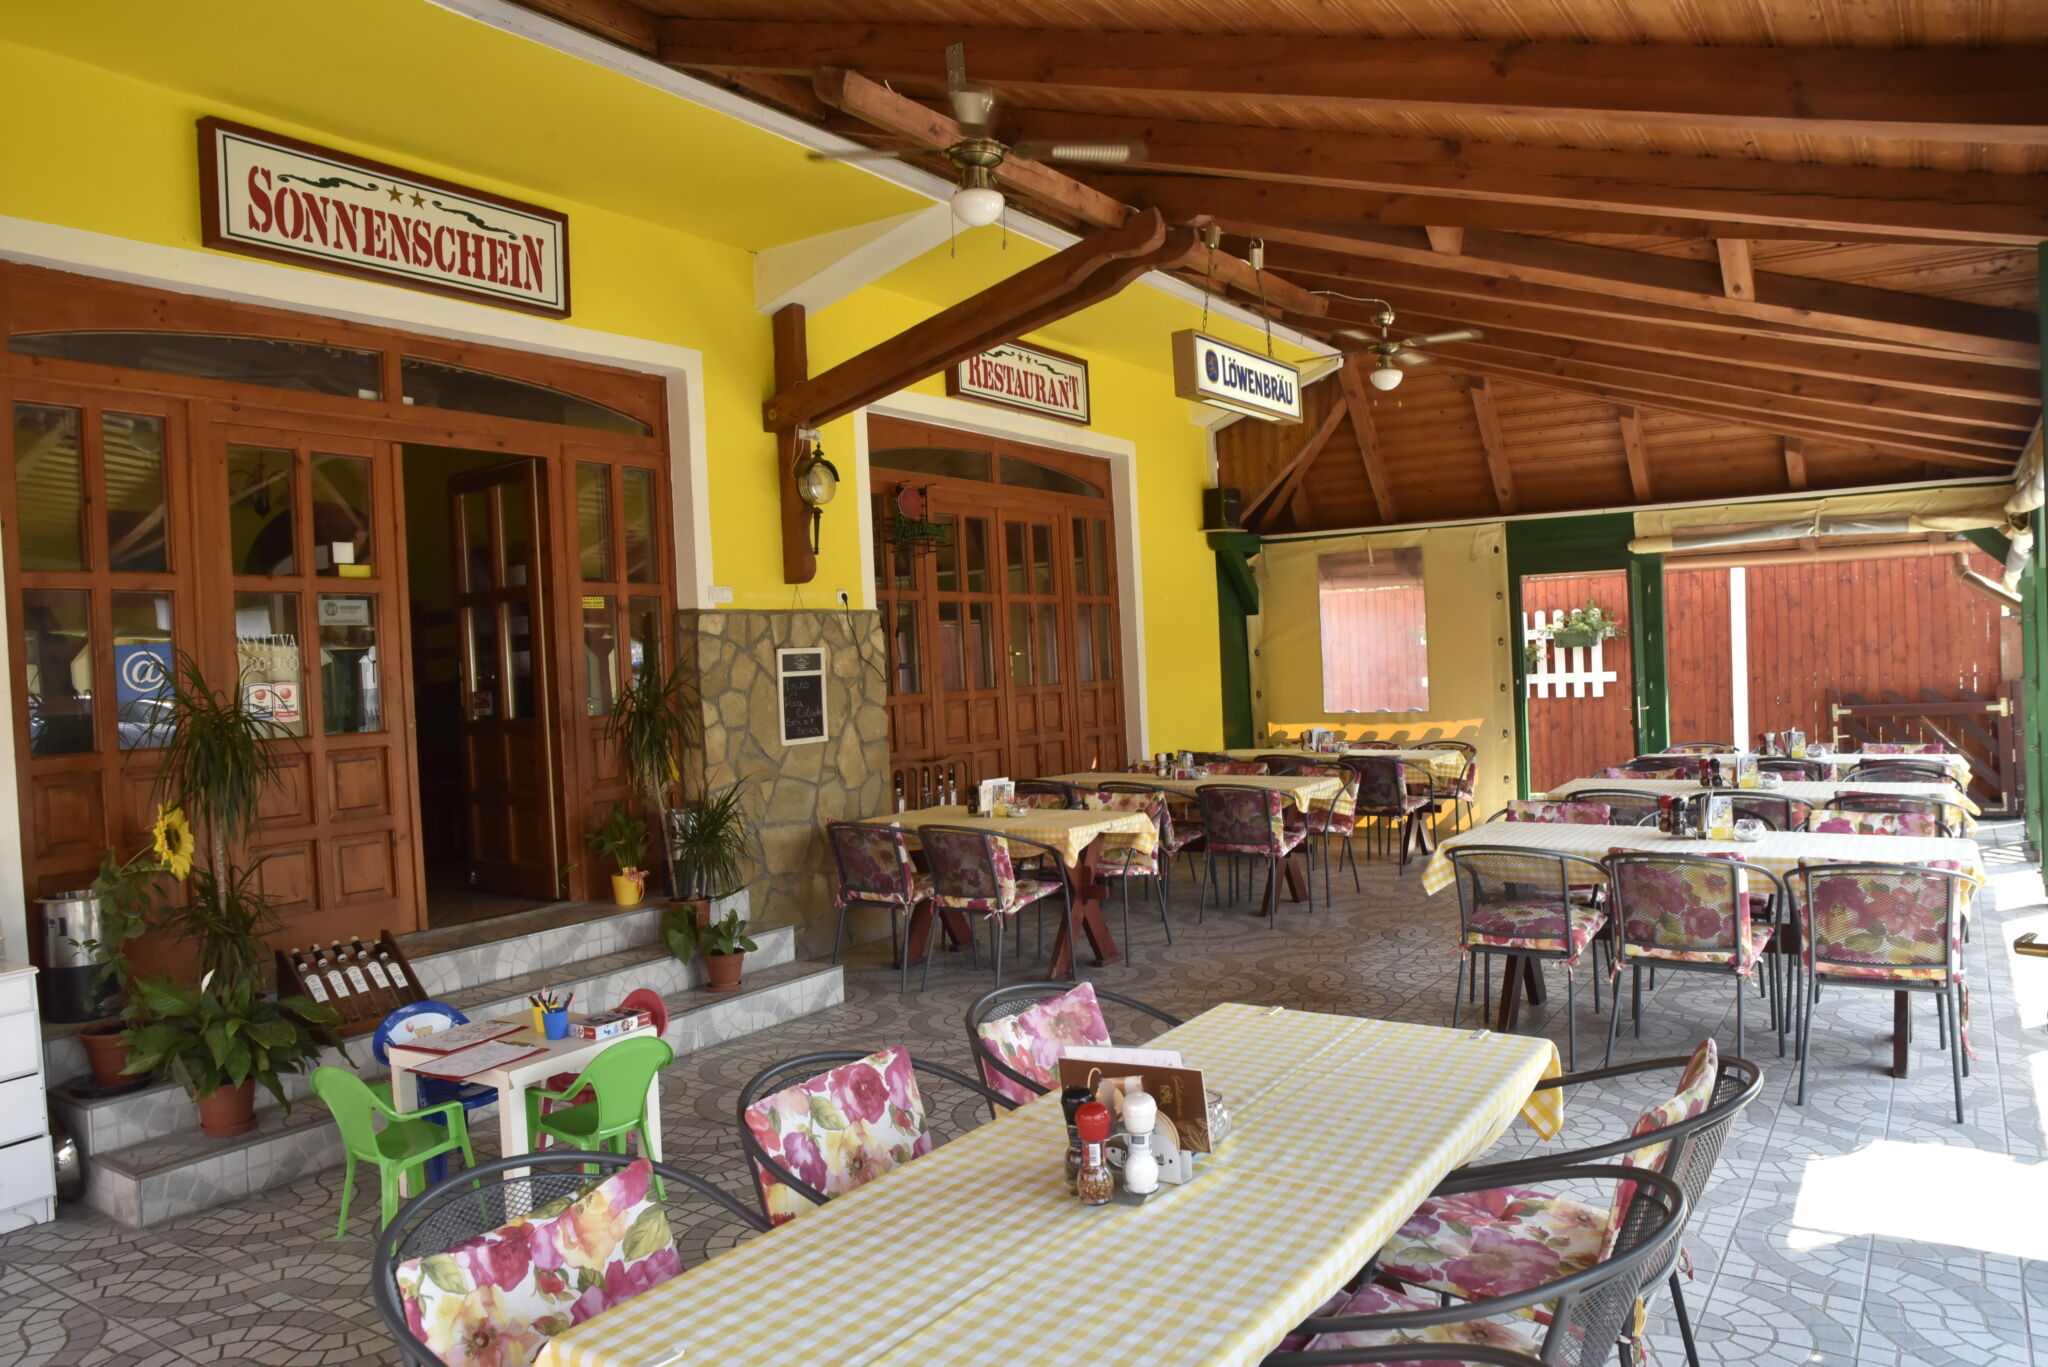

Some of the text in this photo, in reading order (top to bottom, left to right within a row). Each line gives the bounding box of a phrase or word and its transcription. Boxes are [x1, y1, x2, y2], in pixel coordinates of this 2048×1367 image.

[248, 165, 545, 293] SONNENSCHEIN
[968, 353, 1080, 411] RESTAURANT
[1221, 354, 1294, 406] LÖWENBRÄU
[238, 633, 299, 651] NYITVA
